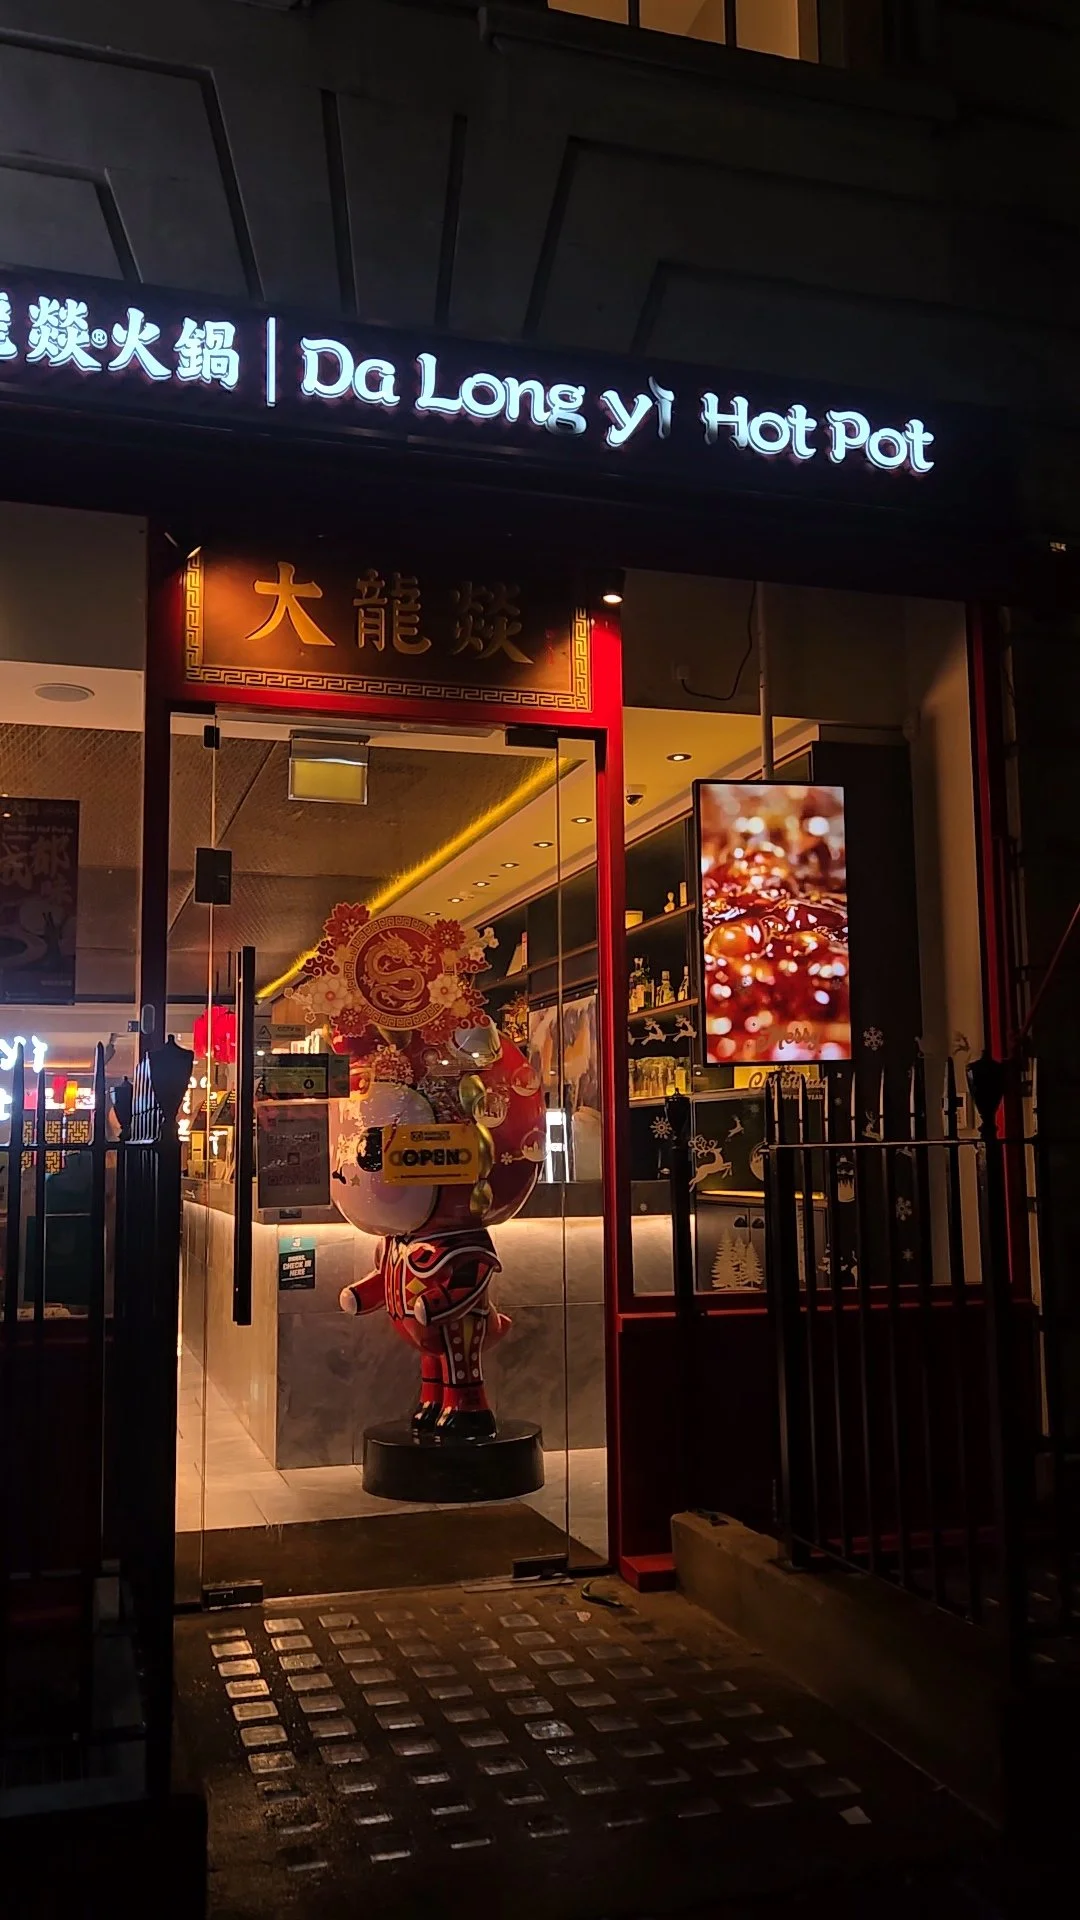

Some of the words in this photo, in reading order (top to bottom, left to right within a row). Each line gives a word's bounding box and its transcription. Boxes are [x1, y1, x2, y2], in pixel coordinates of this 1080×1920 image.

[300, 337, 400, 407] Da
[415, 353, 587, 437] Long
[701, 392, 818, 460] Hot
[826, 410, 935, 473] Pot
[402, 1148, 460, 1167] OPEN
[282, 1261, 304, 1271] CHECK
